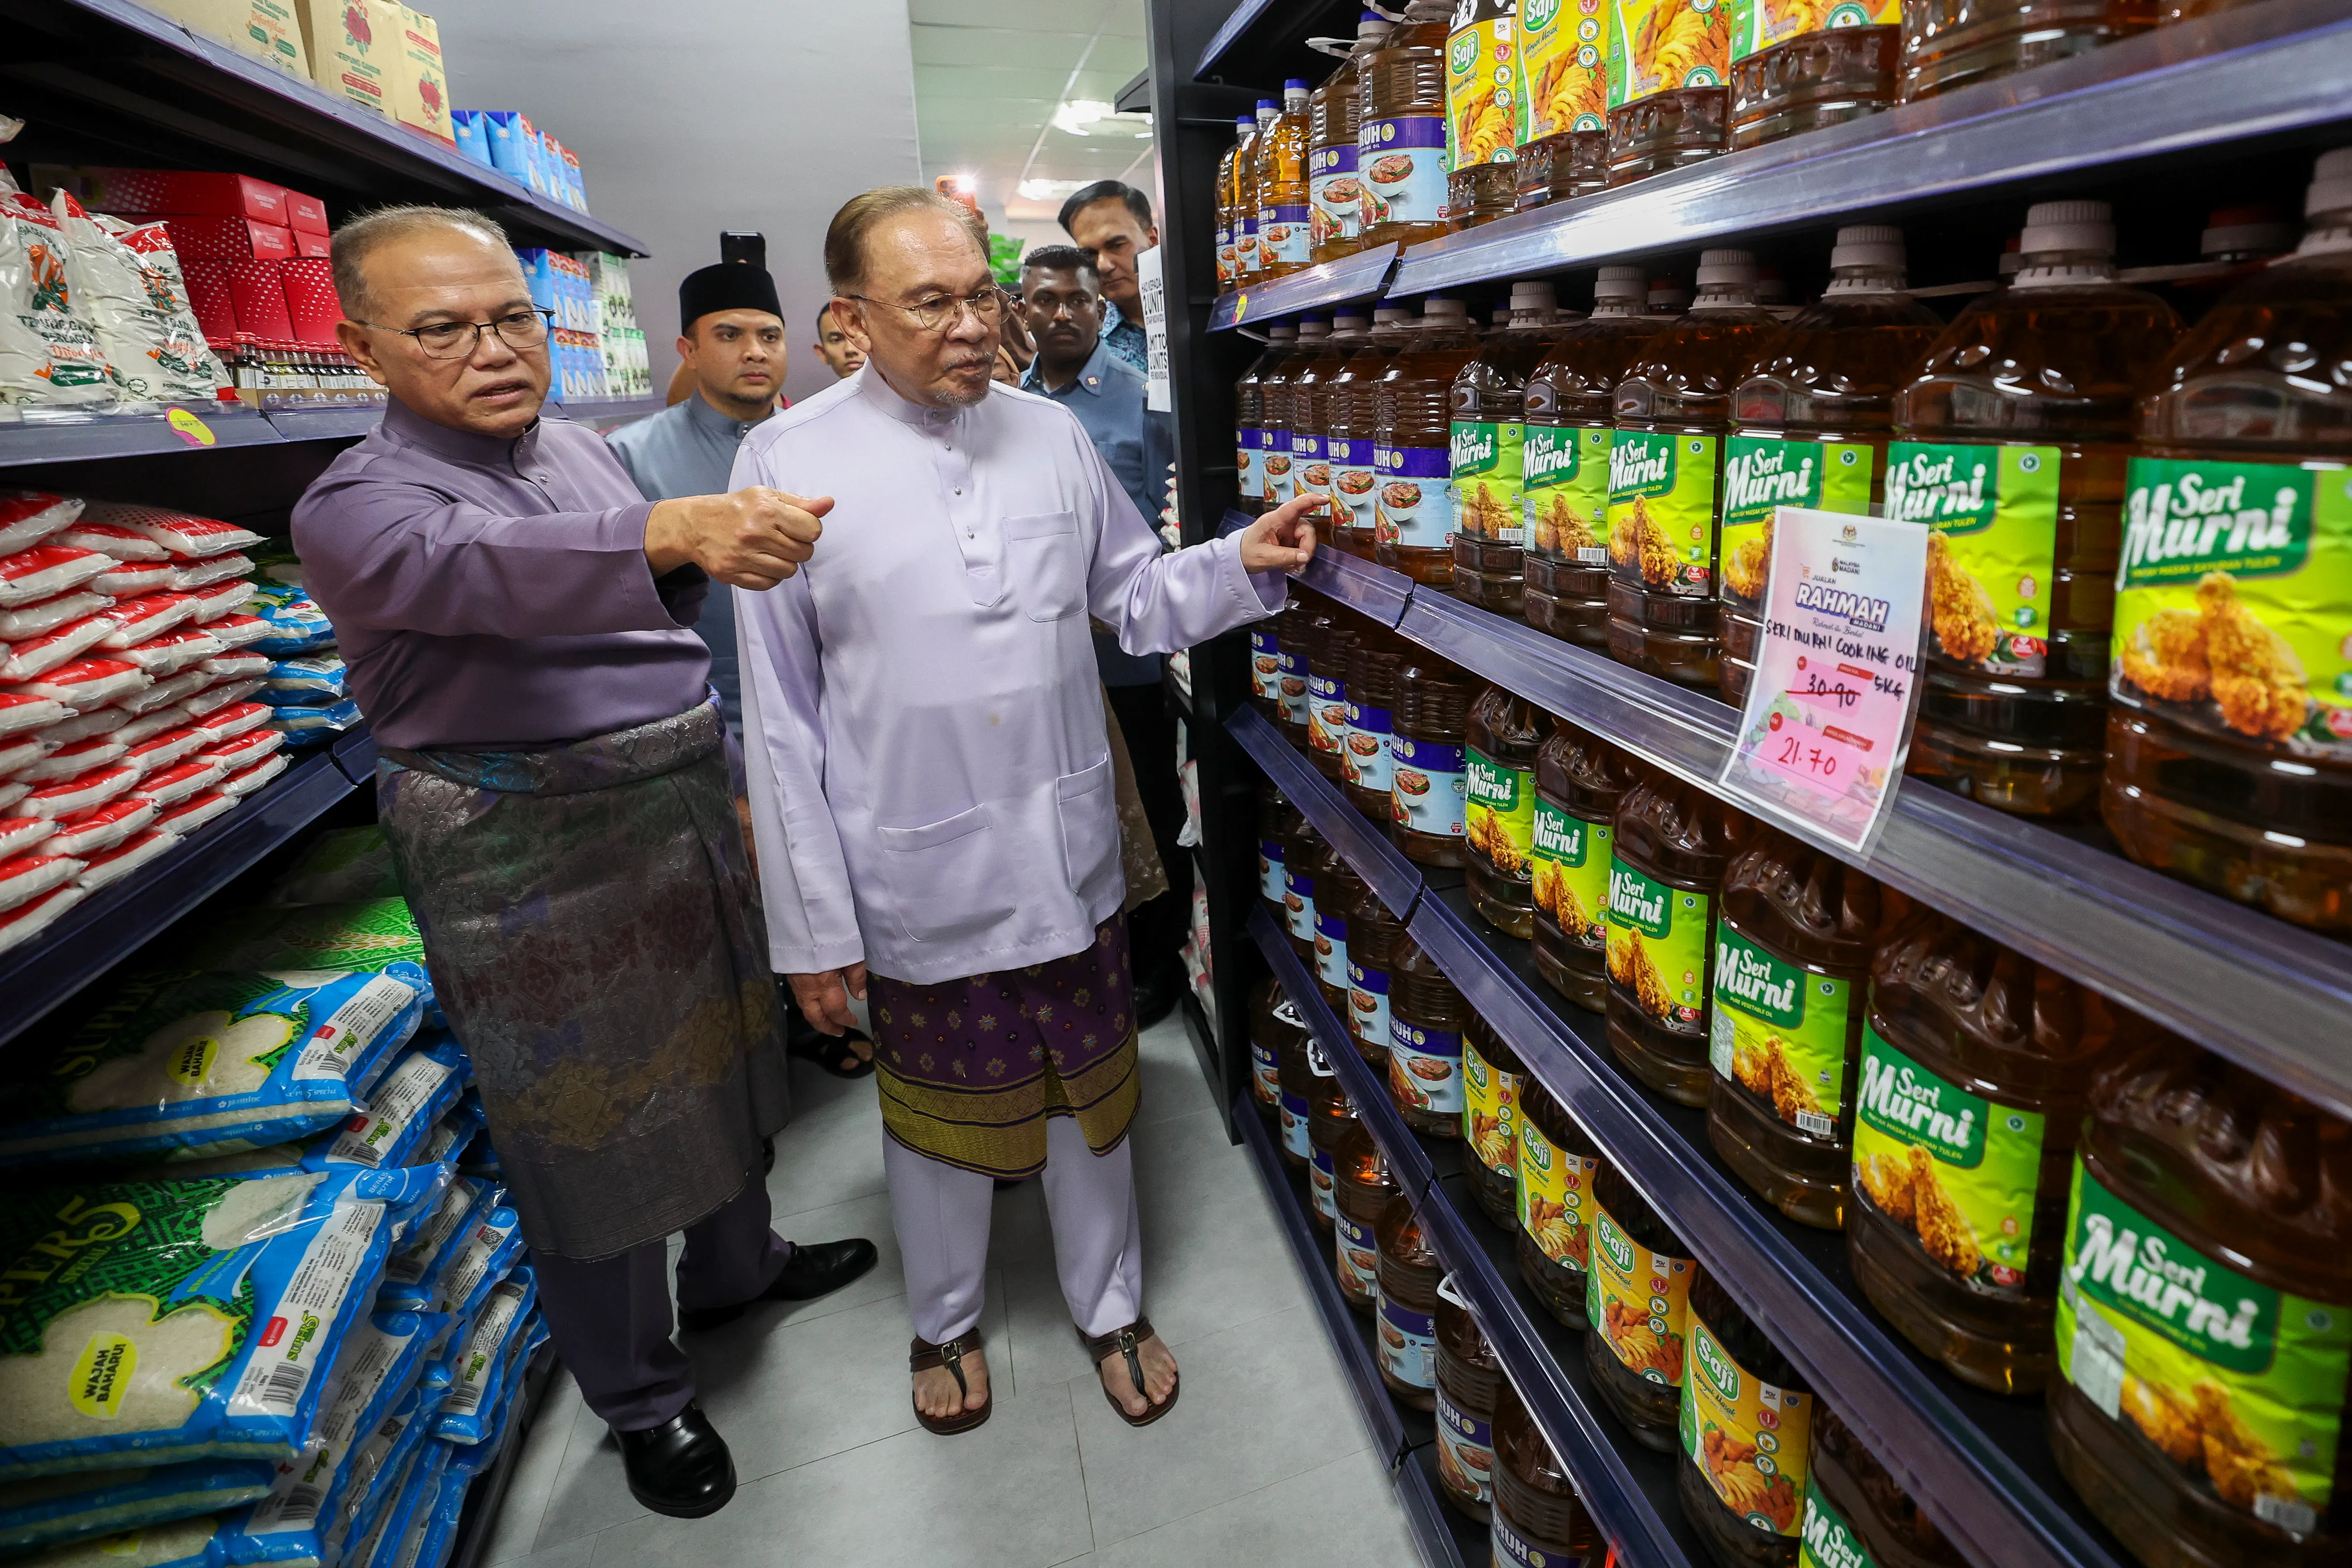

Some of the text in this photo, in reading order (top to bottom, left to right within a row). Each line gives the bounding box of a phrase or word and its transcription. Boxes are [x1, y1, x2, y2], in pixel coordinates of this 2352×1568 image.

[1453, 37, 1475, 68] Saji
[1451, 434, 1492, 474] Murni
[1461, 429, 1477, 448] Seri
[1536, 433, 1554, 454] Seri
[1626, 438, 1647, 463] Seri
[1523, 438, 1573, 480] Murni
[1608, 446, 1669, 497] Murni
[1752, 447, 1784, 476] Seri
[1908, 453, 1954, 487] Seri
[1722, 455, 1815, 526] Murni
[1885, 463, 1988, 520] Murni
[2170, 472, 2246, 517] Seri
[2114, 483, 2298, 593] Murni
[1812, 574, 1837, 584] JUALAN
[1839, 559, 1861, 567] MALAYSIA
[1839, 566, 1861, 575] MADANI
[1796, 582, 1891, 624] RAHMAH
[1852, 619, 1881, 631] MADANI
[1766, 619, 1791, 641] SERI
[1836, 638, 1890, 665] COOKING
[1895, 654, 1916, 674] OIL
[1479, 763, 1495, 783] Seri
[1778, 736, 1837, 776] 21.70
[1466, 762, 1512, 801] Murni
[1533, 809, 1581, 855] Murni
[1545, 811, 1564, 834] Seri
[1609, 868, 1664, 925] Murni
[1622, 872, 1645, 898] Seri
[1644, 924, 1658, 933] TULEN
[1713, 942, 1796, 1012] Murni
[1739, 949, 1772, 982] Seri
[1730, 997, 1741, 1006] PURE
[1741, 1000, 1766, 1015] VEGETABLE
[179, 1045, 197, 1075] WAJAH
[1467, 1050, 1486, 1084] Saji
[1857, 1054, 1975, 1149] Murni
[1895, 1067, 1940, 1109] Seri
[1525, 1127, 1548, 1165] Saji
[1600, 1220, 1631, 1266] Saji
[1597, 1253, 1632, 1287] Minyak Masak
[2069, 1212, 2261, 1350] Murni
[2138, 1236, 2207, 1295] Seri
[83, 1349, 110, 1399] WAJAH
[1698, 1336, 1734, 1393] Saji
[1694, 1372, 1736, 1418] Minyak Masak
